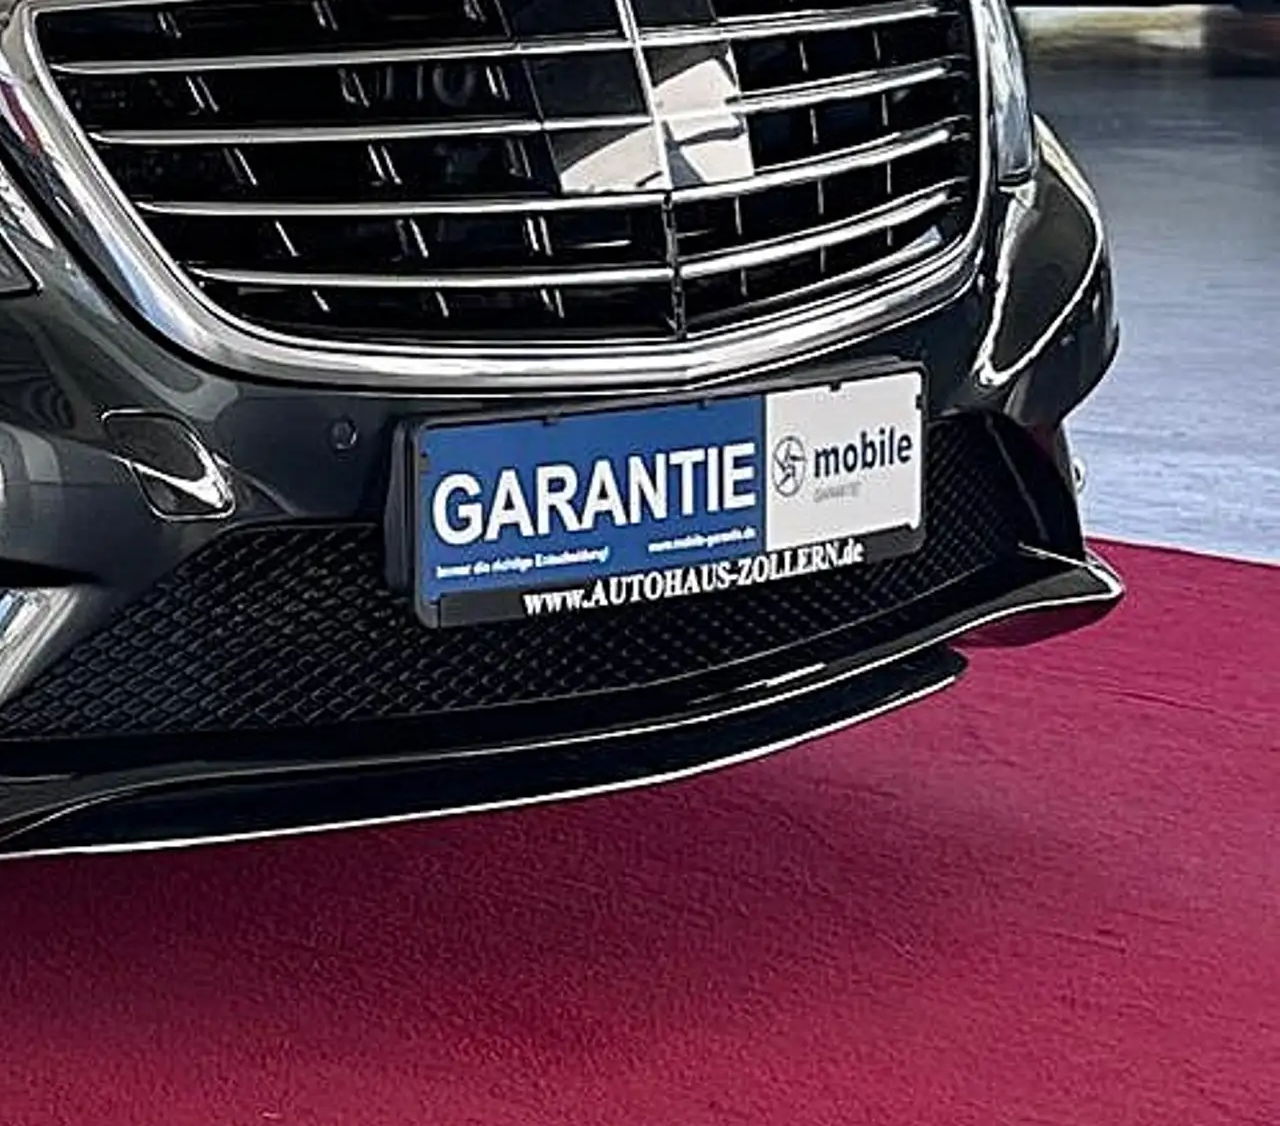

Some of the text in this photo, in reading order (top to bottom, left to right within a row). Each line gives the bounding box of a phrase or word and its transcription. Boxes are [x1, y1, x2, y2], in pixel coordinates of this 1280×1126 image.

[813, 425, 913, 479] mobile
[431, 441, 756, 546] GARANTIE
[523, 537, 864, 617] www.AUTOHAUS-ZOLLERN.de
